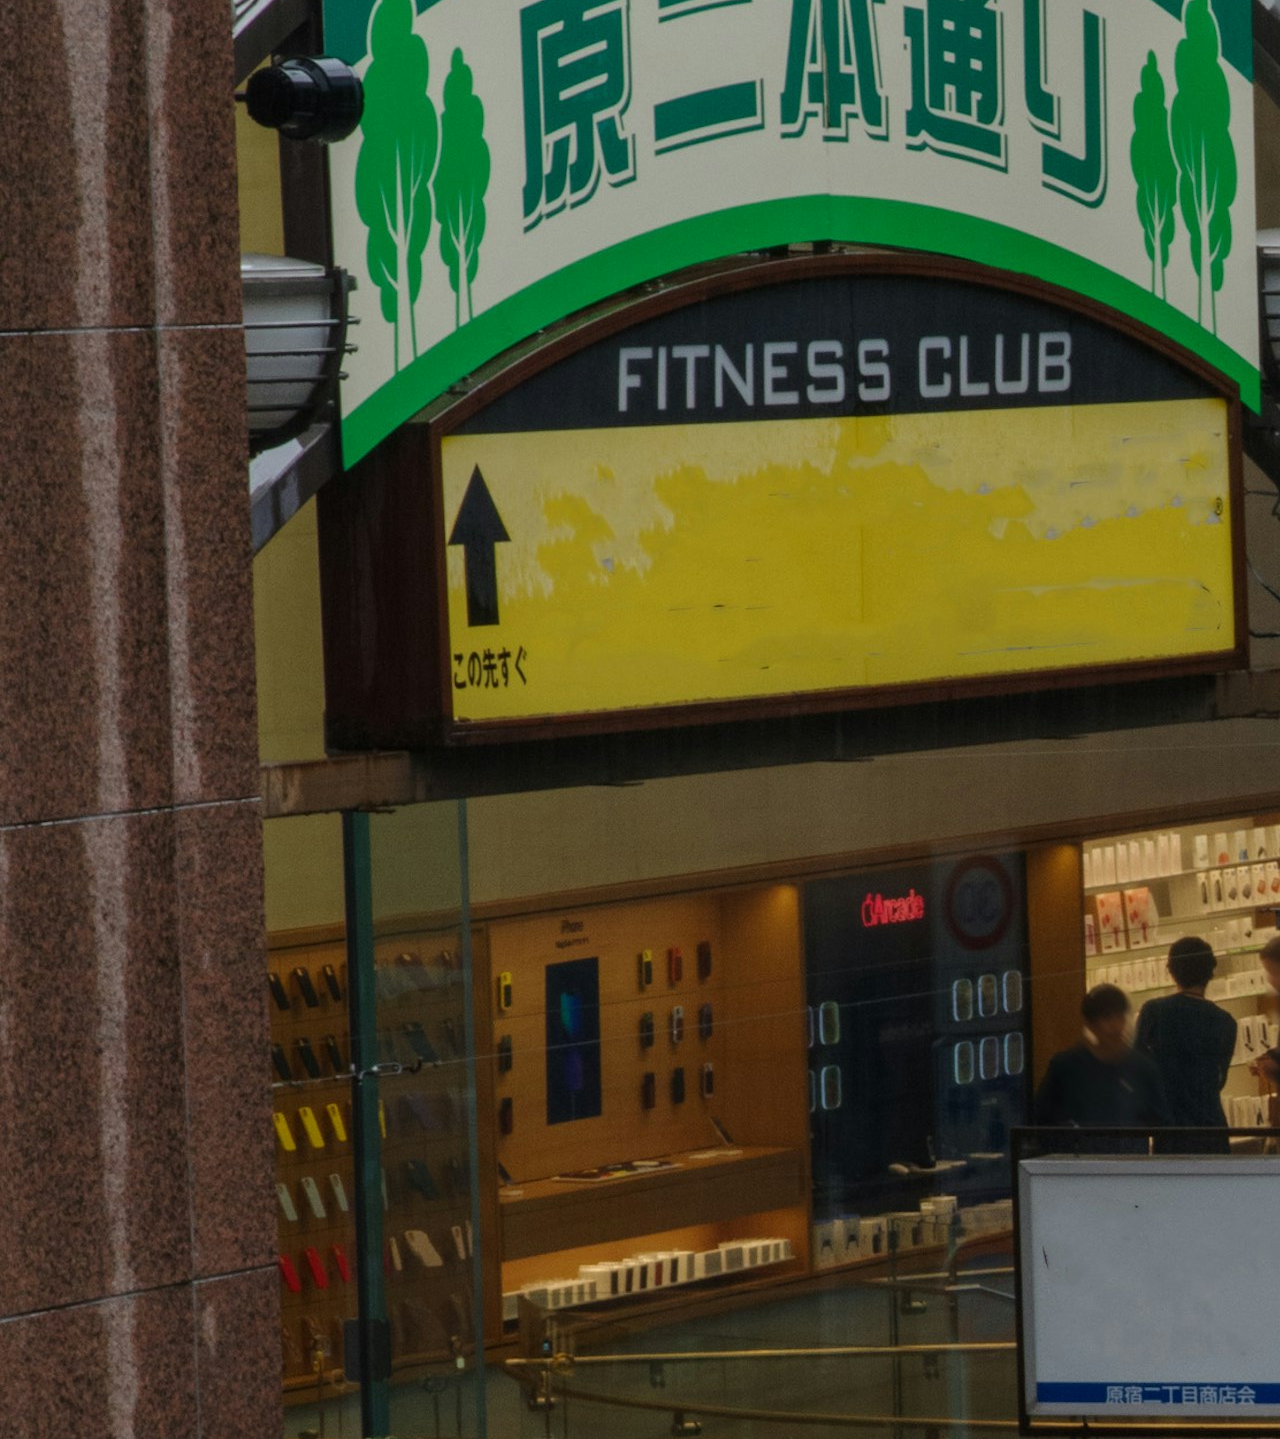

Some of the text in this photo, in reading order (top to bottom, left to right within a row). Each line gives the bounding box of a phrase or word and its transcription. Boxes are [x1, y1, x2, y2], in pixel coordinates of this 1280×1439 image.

[617, 331, 1073, 413] FITNESS CLUB
[453, 645, 528, 690] この先すぐ
[872, 888, 926, 926] Arcade
[1105, 1385, 1257, 1404] 原宿二丁目商店会
